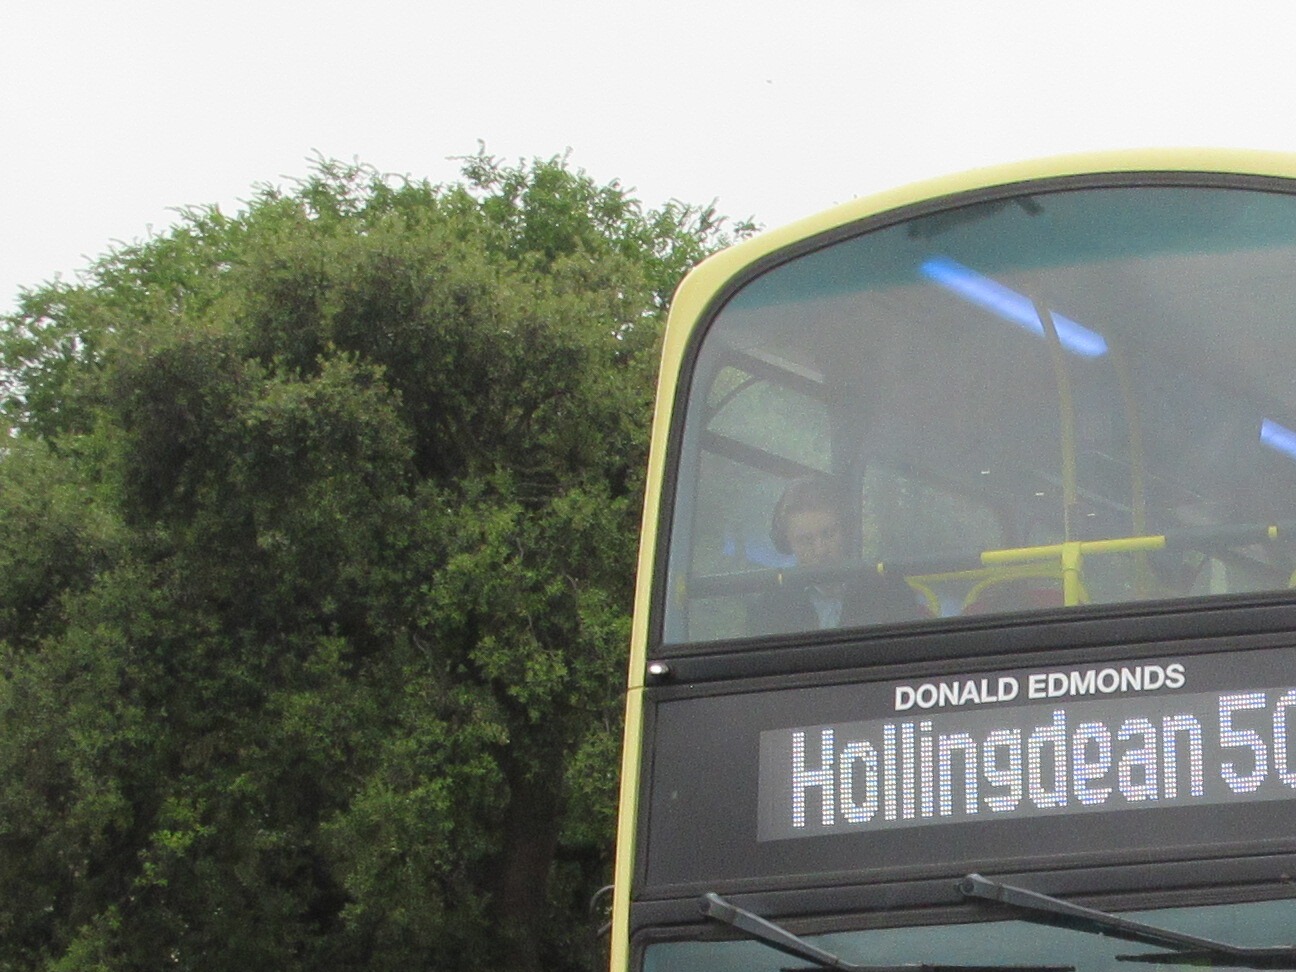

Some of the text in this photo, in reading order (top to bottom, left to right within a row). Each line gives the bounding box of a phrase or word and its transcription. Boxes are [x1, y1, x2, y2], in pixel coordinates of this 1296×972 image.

[894, 663, 1186, 711] DONALD EDMONDS
[791, 709, 1205, 828] Hollingdean
